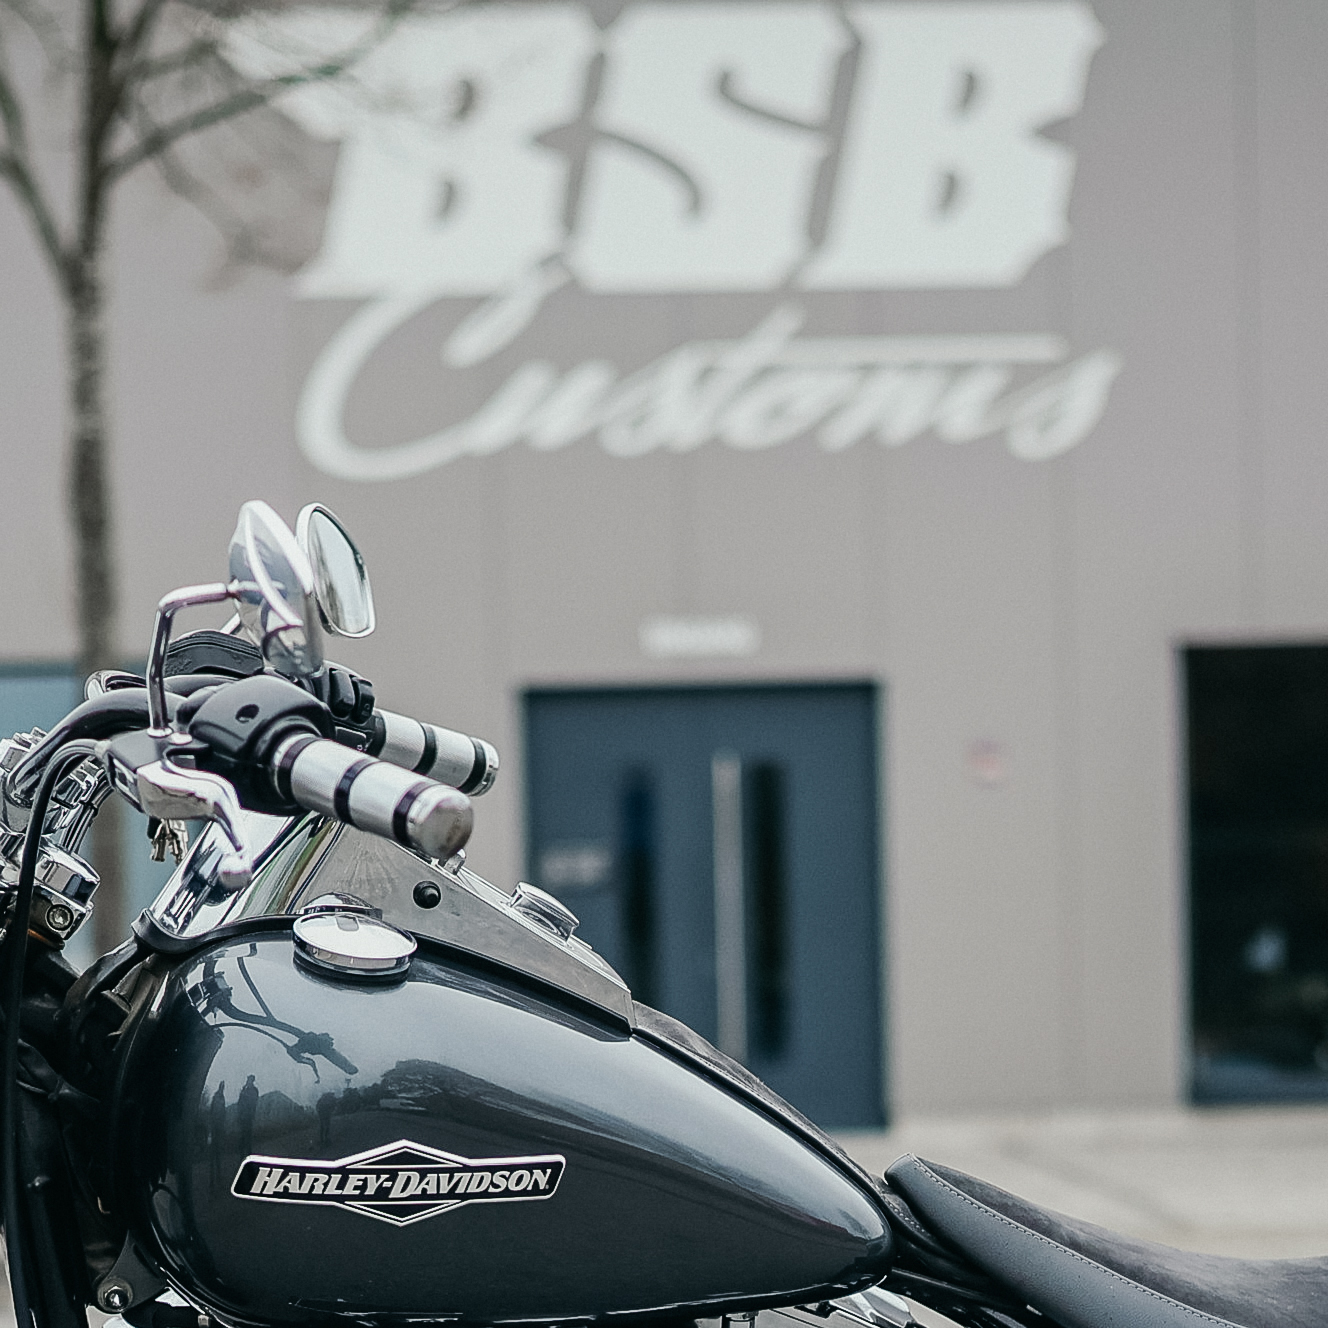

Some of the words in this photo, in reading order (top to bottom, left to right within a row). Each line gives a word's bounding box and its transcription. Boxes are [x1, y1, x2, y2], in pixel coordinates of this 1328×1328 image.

[194, 2, 1104, 298] BSB
[296, 252, 1123, 481] Customs
[251, 1168, 550, 1198] HARLEY-DAVIDSON
